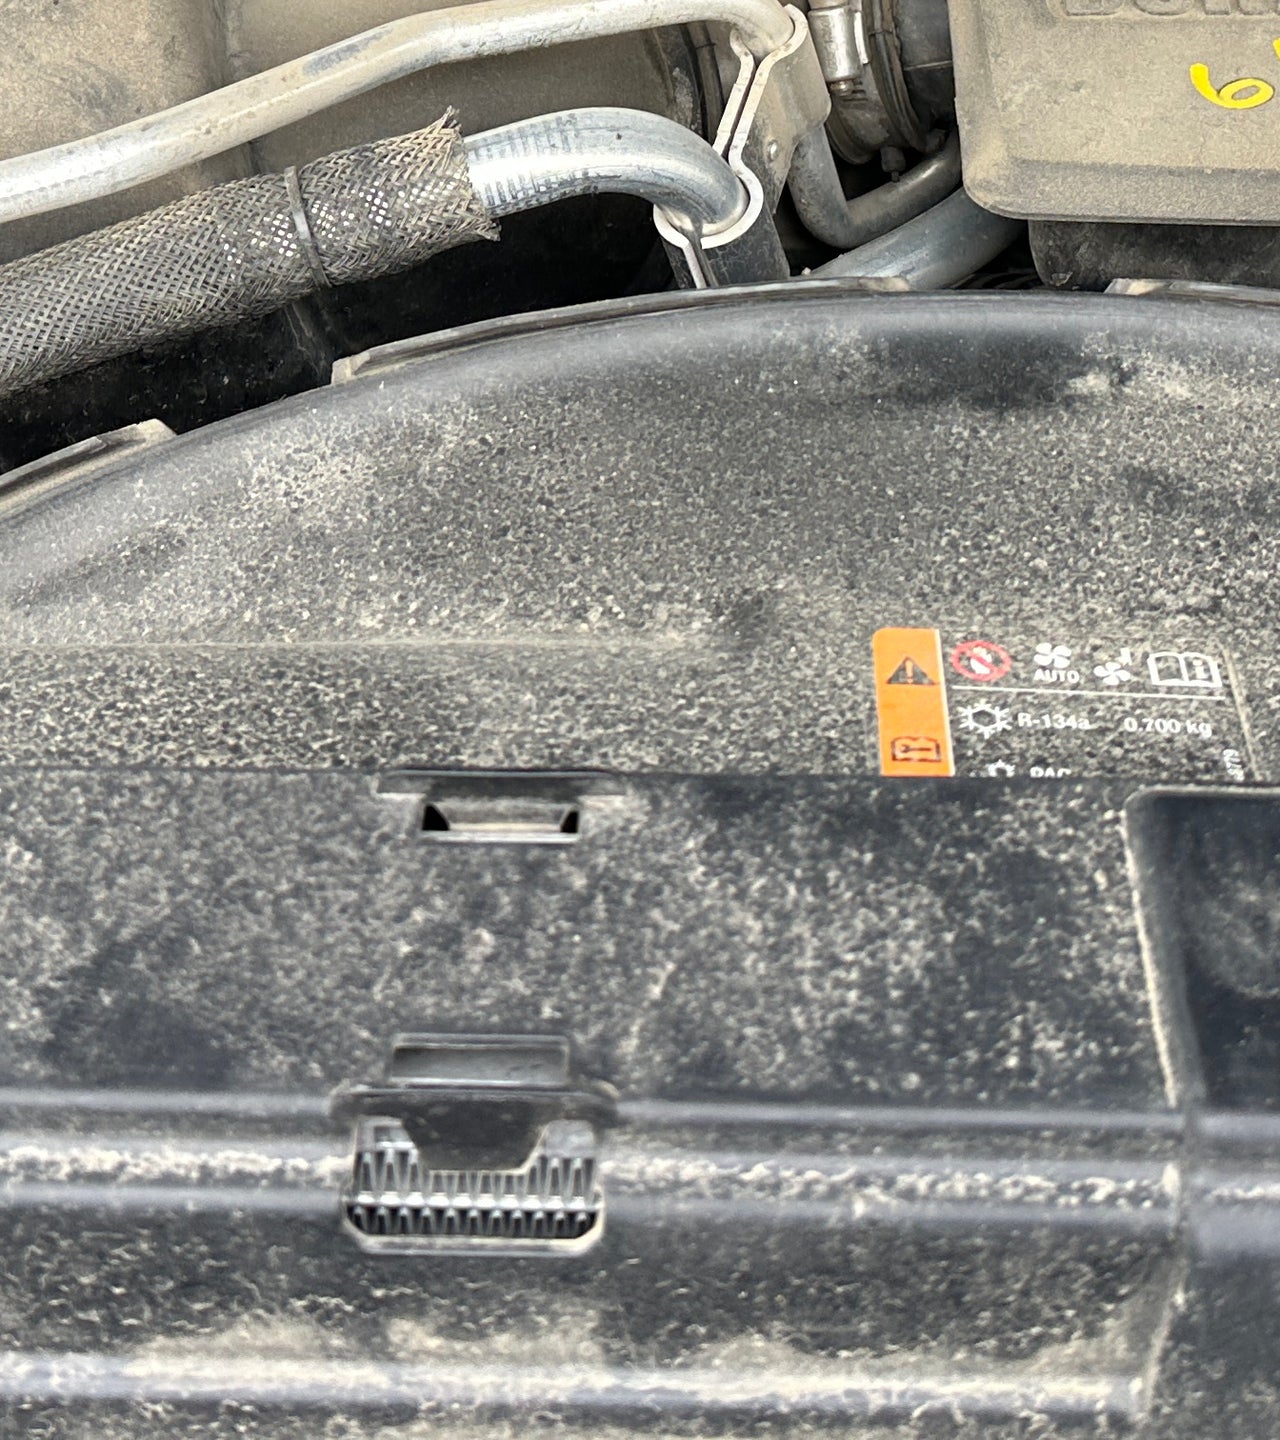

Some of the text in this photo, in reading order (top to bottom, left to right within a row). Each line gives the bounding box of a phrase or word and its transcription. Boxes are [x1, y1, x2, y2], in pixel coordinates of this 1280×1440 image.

[1033, 668, 1080, 684] AUTO
[1017, 712, 1213, 738] R-134a 0.700 kg
